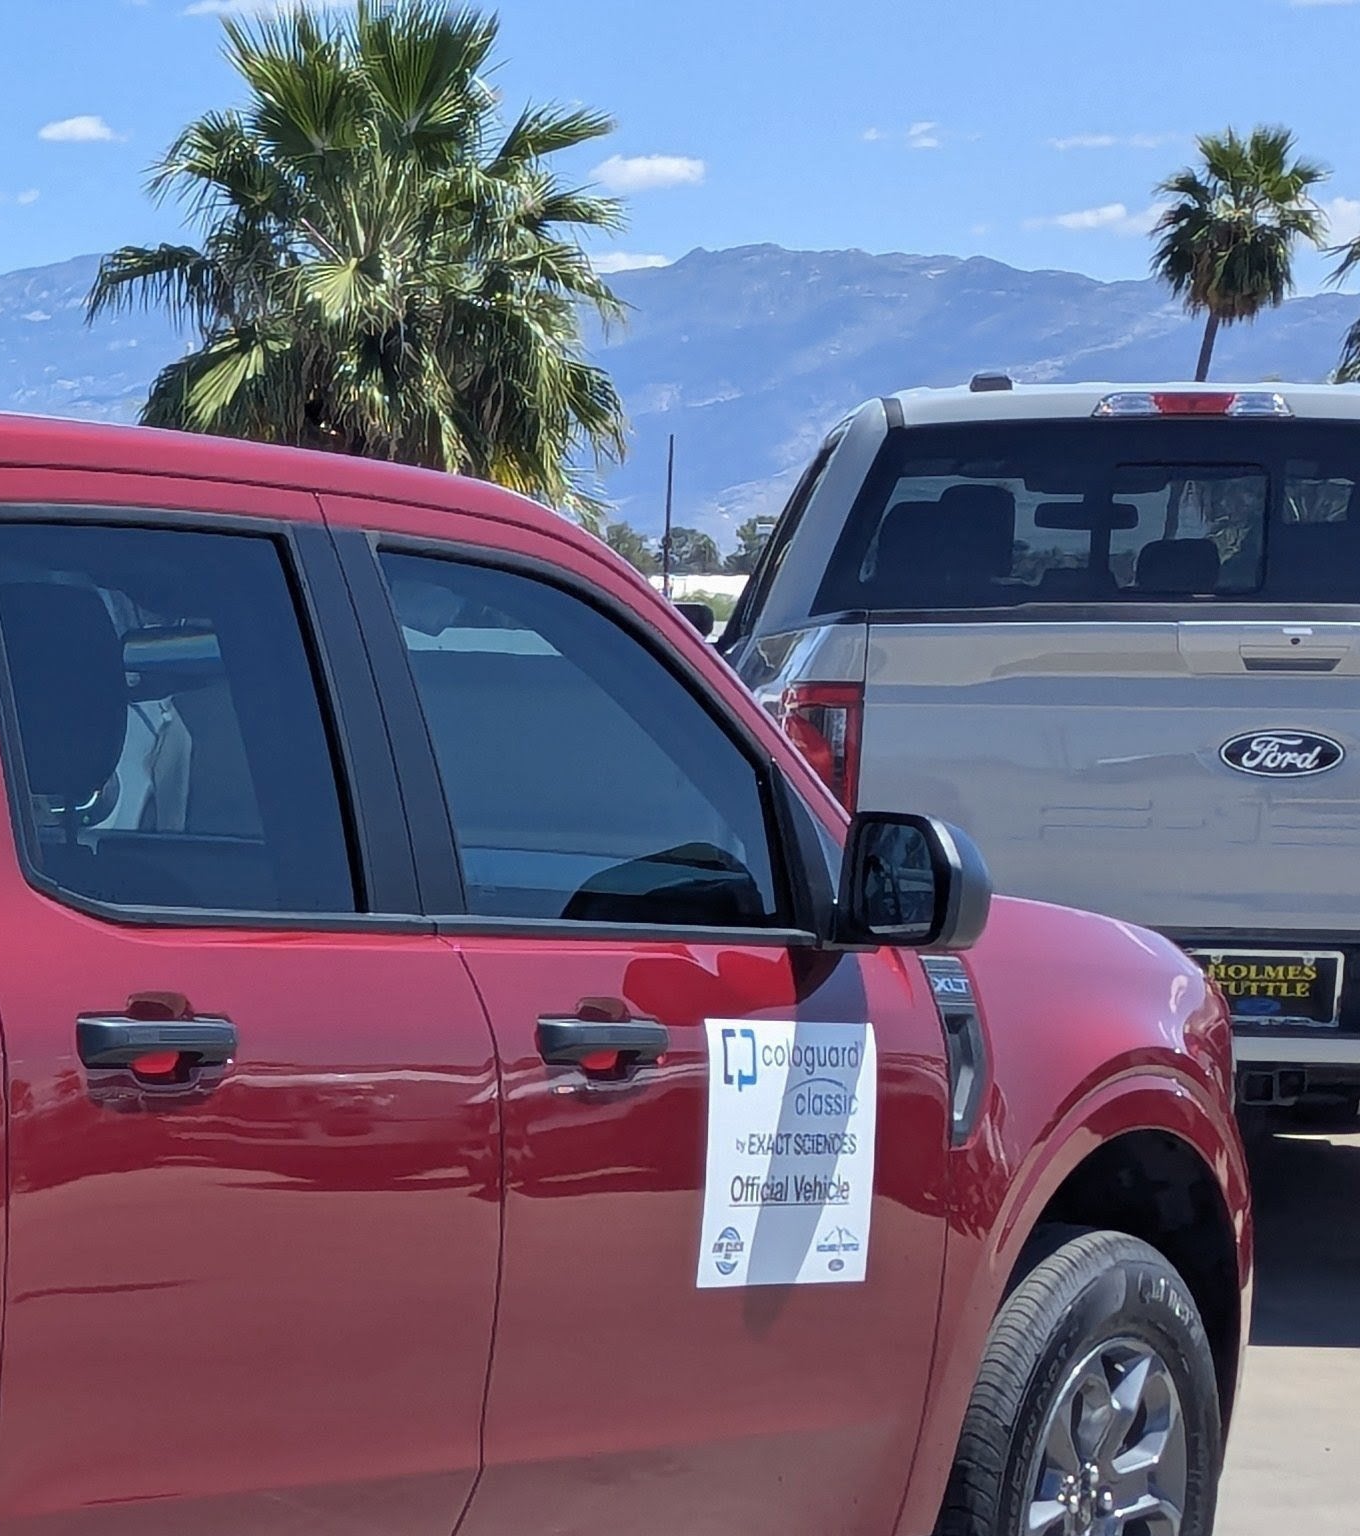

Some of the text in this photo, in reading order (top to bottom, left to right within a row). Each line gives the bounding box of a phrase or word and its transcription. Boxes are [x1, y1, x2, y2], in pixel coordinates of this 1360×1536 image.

[1241, 736, 1323, 769] Ford
[933, 977, 970, 994] XLT
[1207, 964, 1318, 981] HOLMES
[762, 1037, 860, 1076] cologuard
[795, 1086, 859, 1116] classic
[747, 1133, 793, 1156] EXACT
[793, 1133, 858, 1156] SCIENCES
[730, 1173, 851, 1203] Official Vehicle
